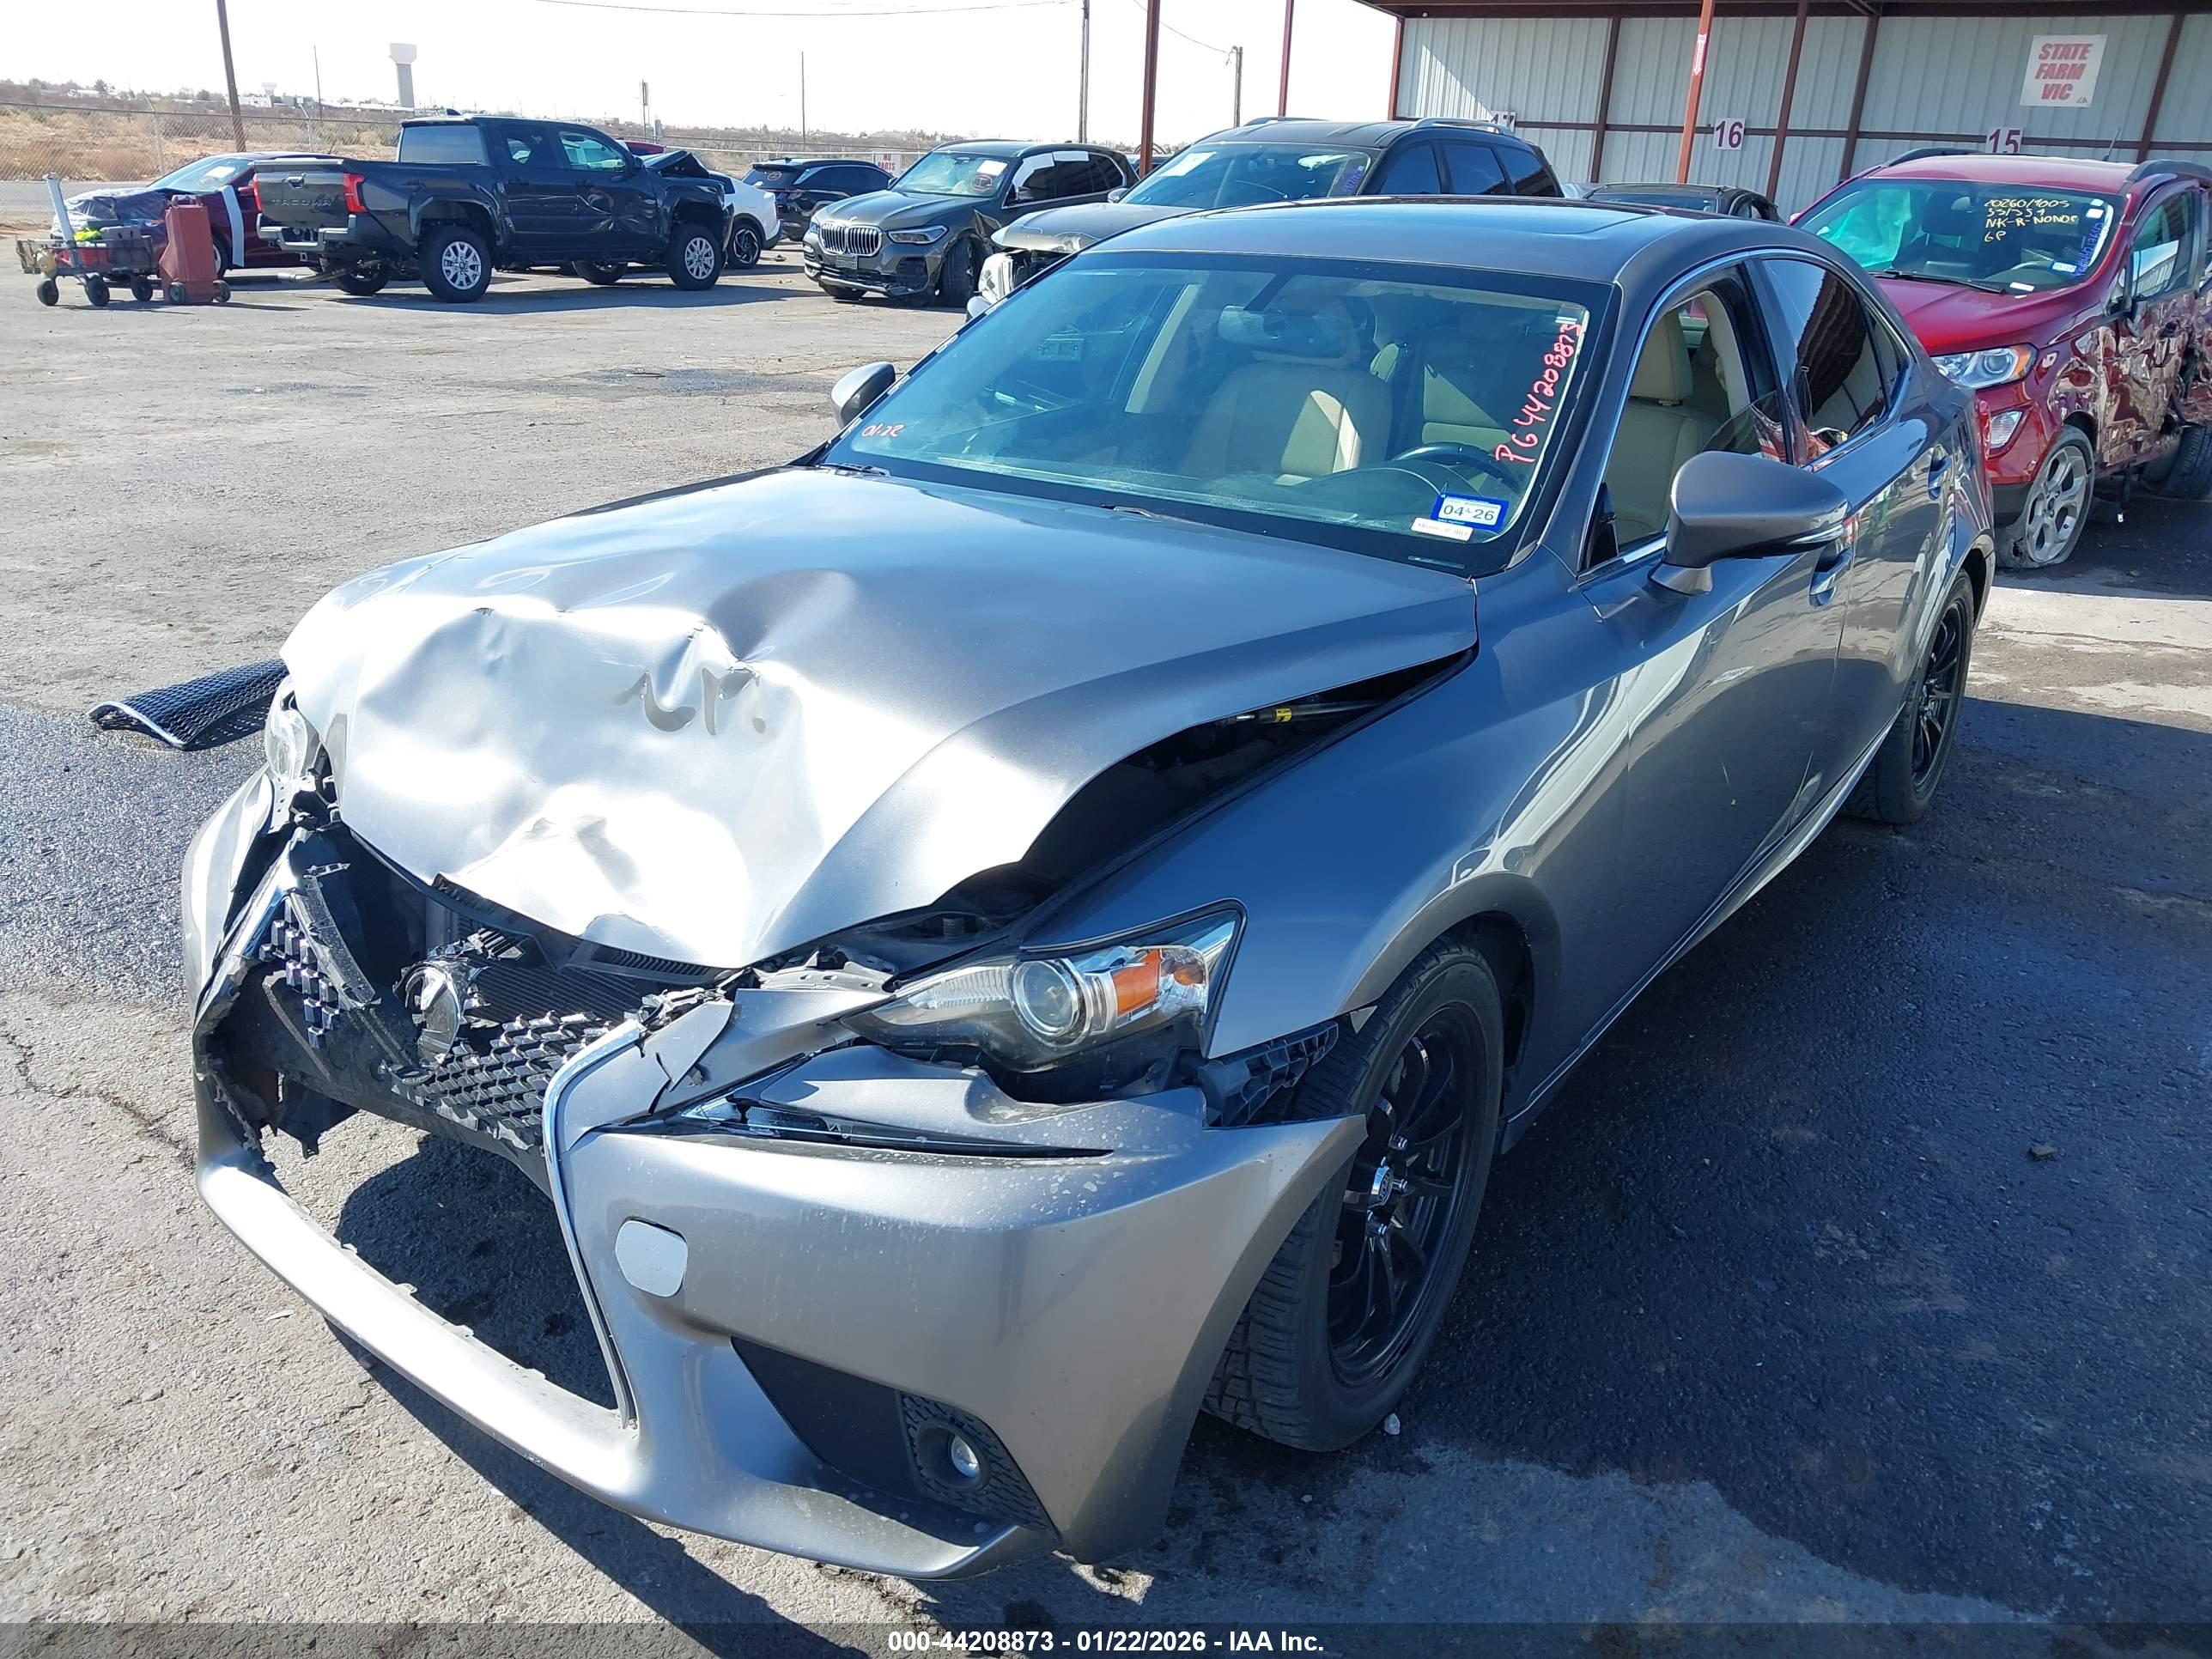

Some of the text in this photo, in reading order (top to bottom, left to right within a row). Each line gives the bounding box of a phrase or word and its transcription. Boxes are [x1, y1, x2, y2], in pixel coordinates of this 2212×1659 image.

[2038, 43, 2094, 60] STATE
[2034, 63, 2087, 80] FARM
[2041, 83, 2074, 100] VIC
[1716, 120, 1743, 149] 16
[1989, 129, 2021, 154] 15
[1443, 504, 1464, 517] 04
[1473, 508, 1495, 521] 26
